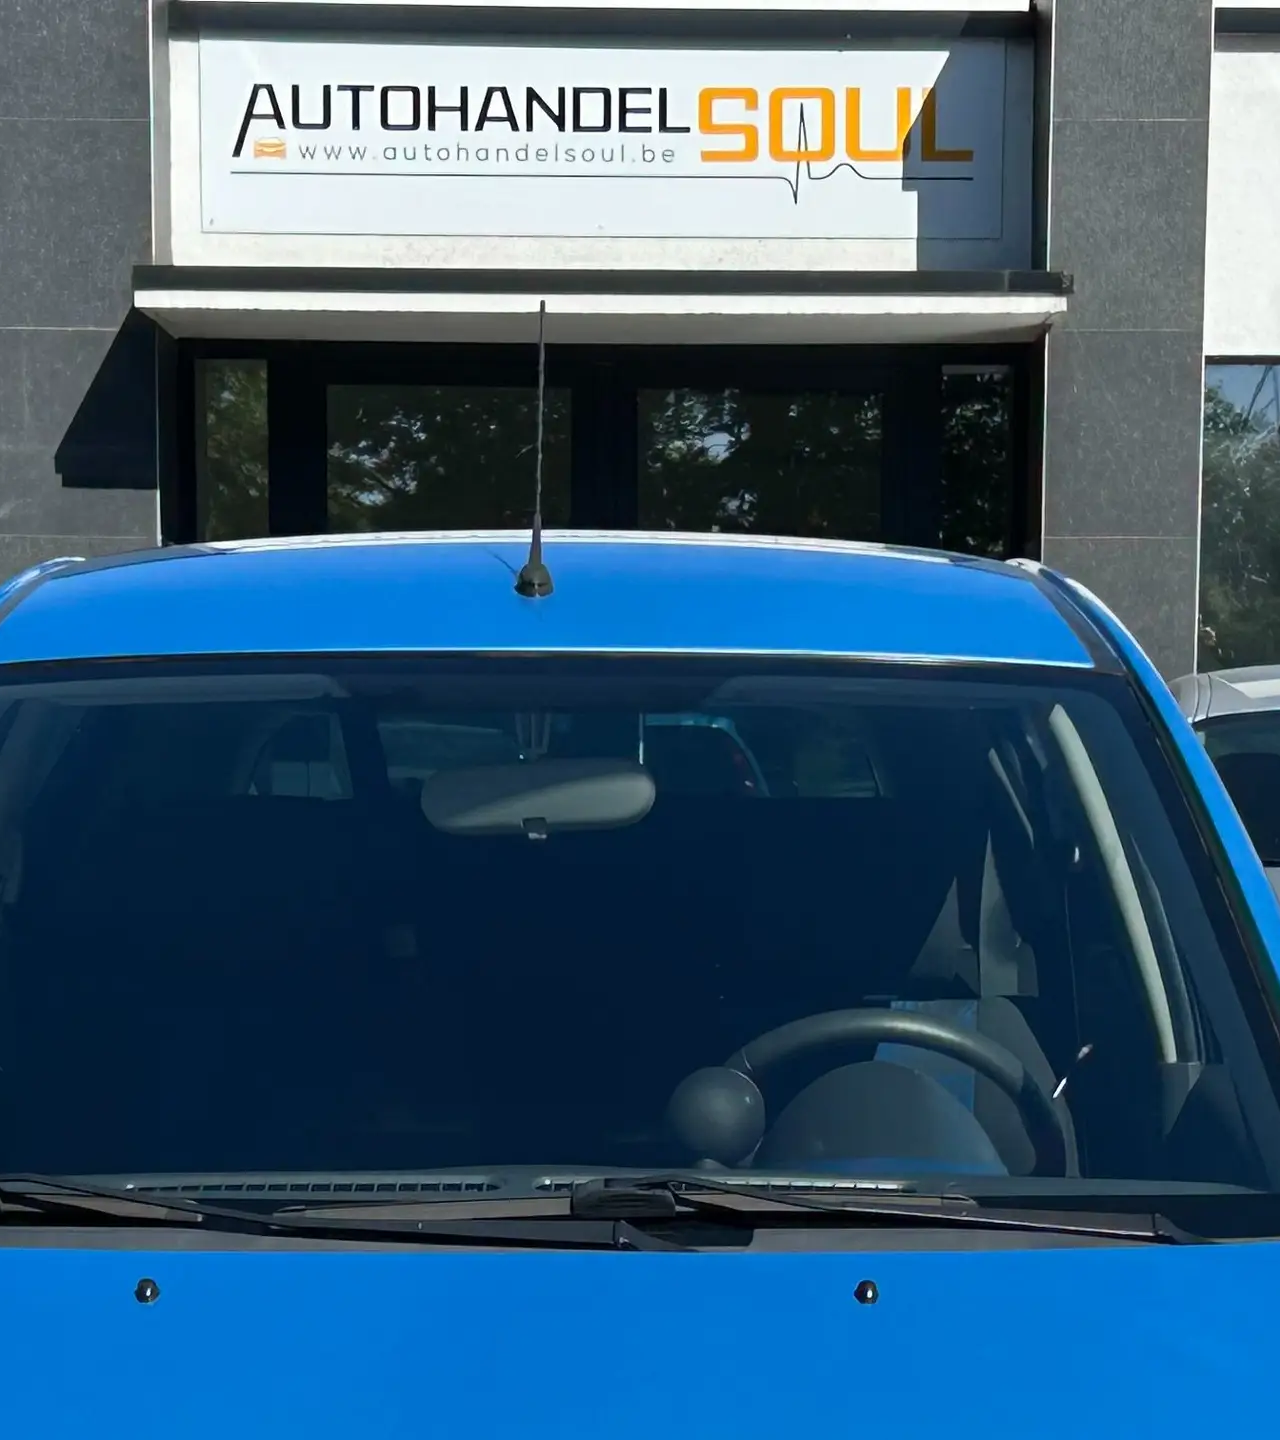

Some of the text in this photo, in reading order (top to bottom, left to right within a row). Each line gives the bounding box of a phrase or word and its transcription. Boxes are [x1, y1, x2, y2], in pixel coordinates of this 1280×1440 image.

[231, 83, 974, 163] AUTOHANDEL SOUL
[298, 141, 676, 164] www.autohandelsoul.be
